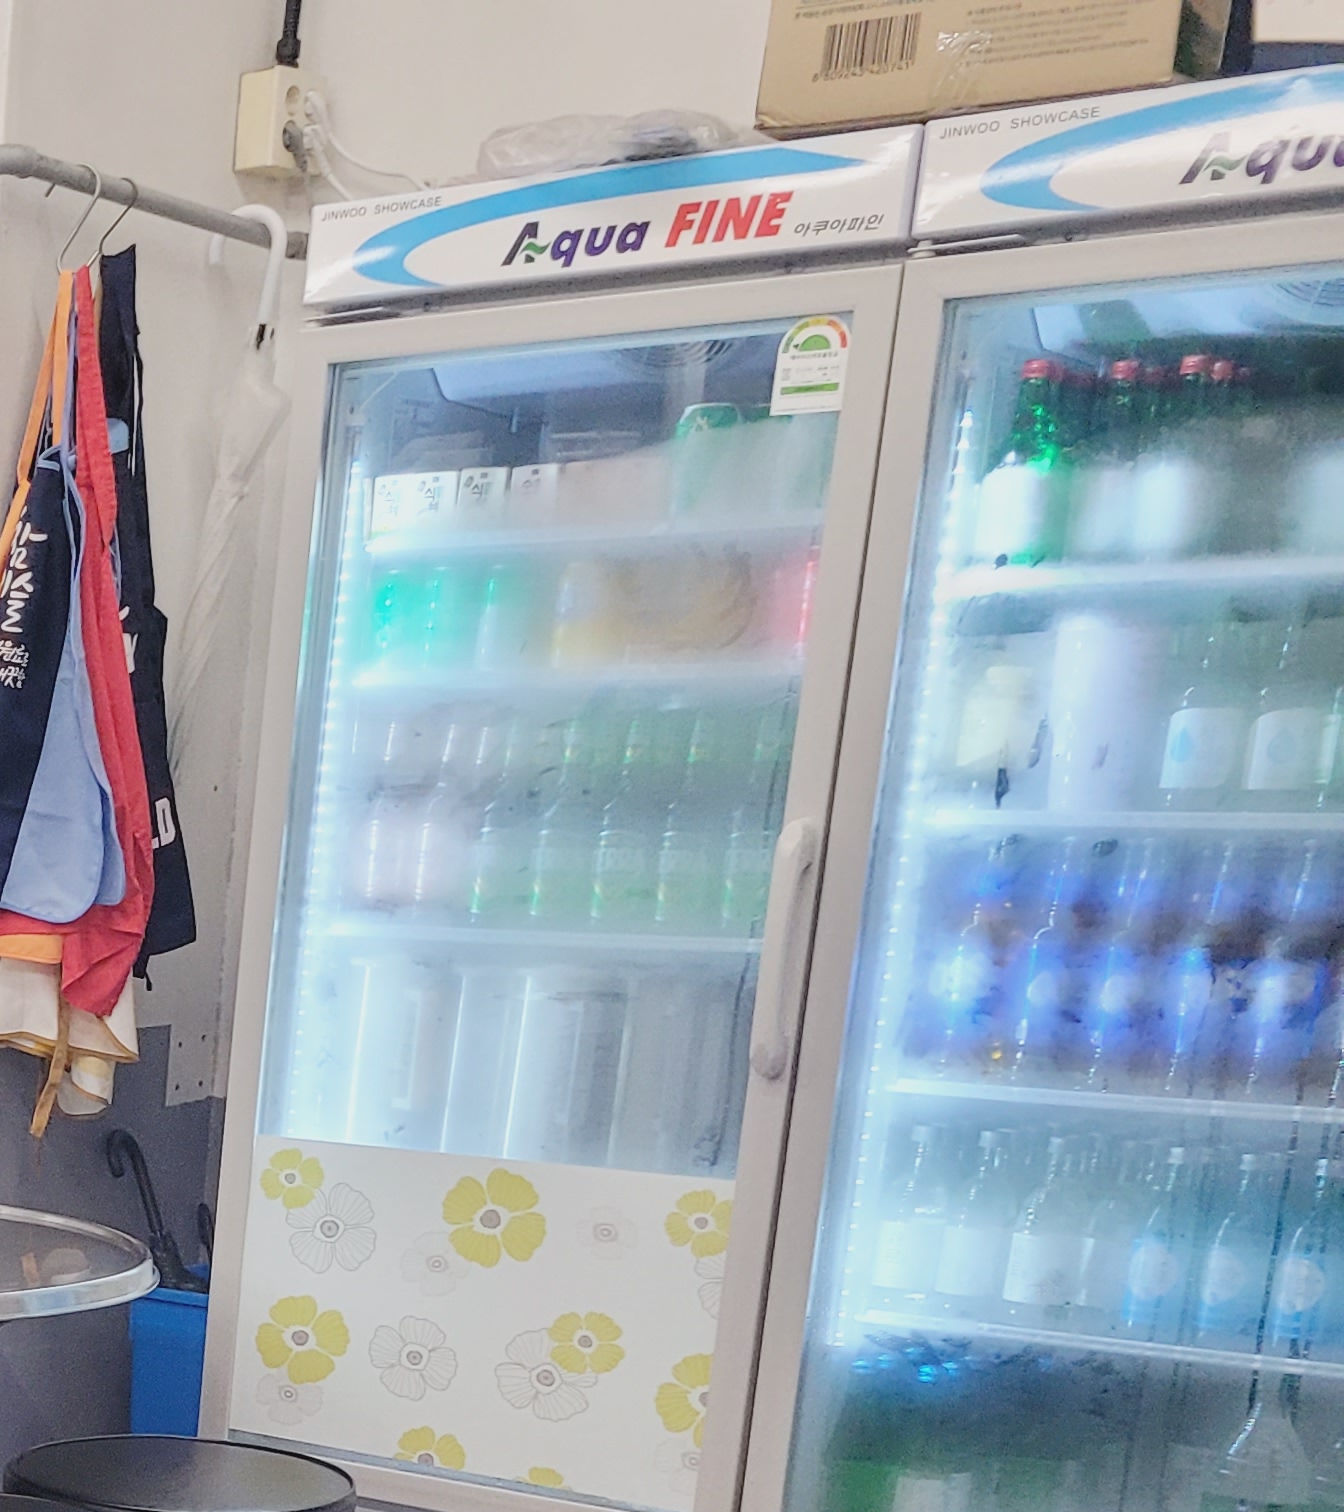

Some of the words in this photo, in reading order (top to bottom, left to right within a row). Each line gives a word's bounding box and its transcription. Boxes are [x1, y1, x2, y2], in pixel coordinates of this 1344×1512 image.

[939, 121, 1001, 140] JINWOO
[1009, 106, 1103, 130] SHOWCASE
[321, 206, 367, 222] JINWOO
[373, 196, 443, 215] SHOWCASE
[500, 220, 652, 268] Aqua
[664, 190, 794, 248] FINE
[793, 213, 885, 238] 아쿠아파인
